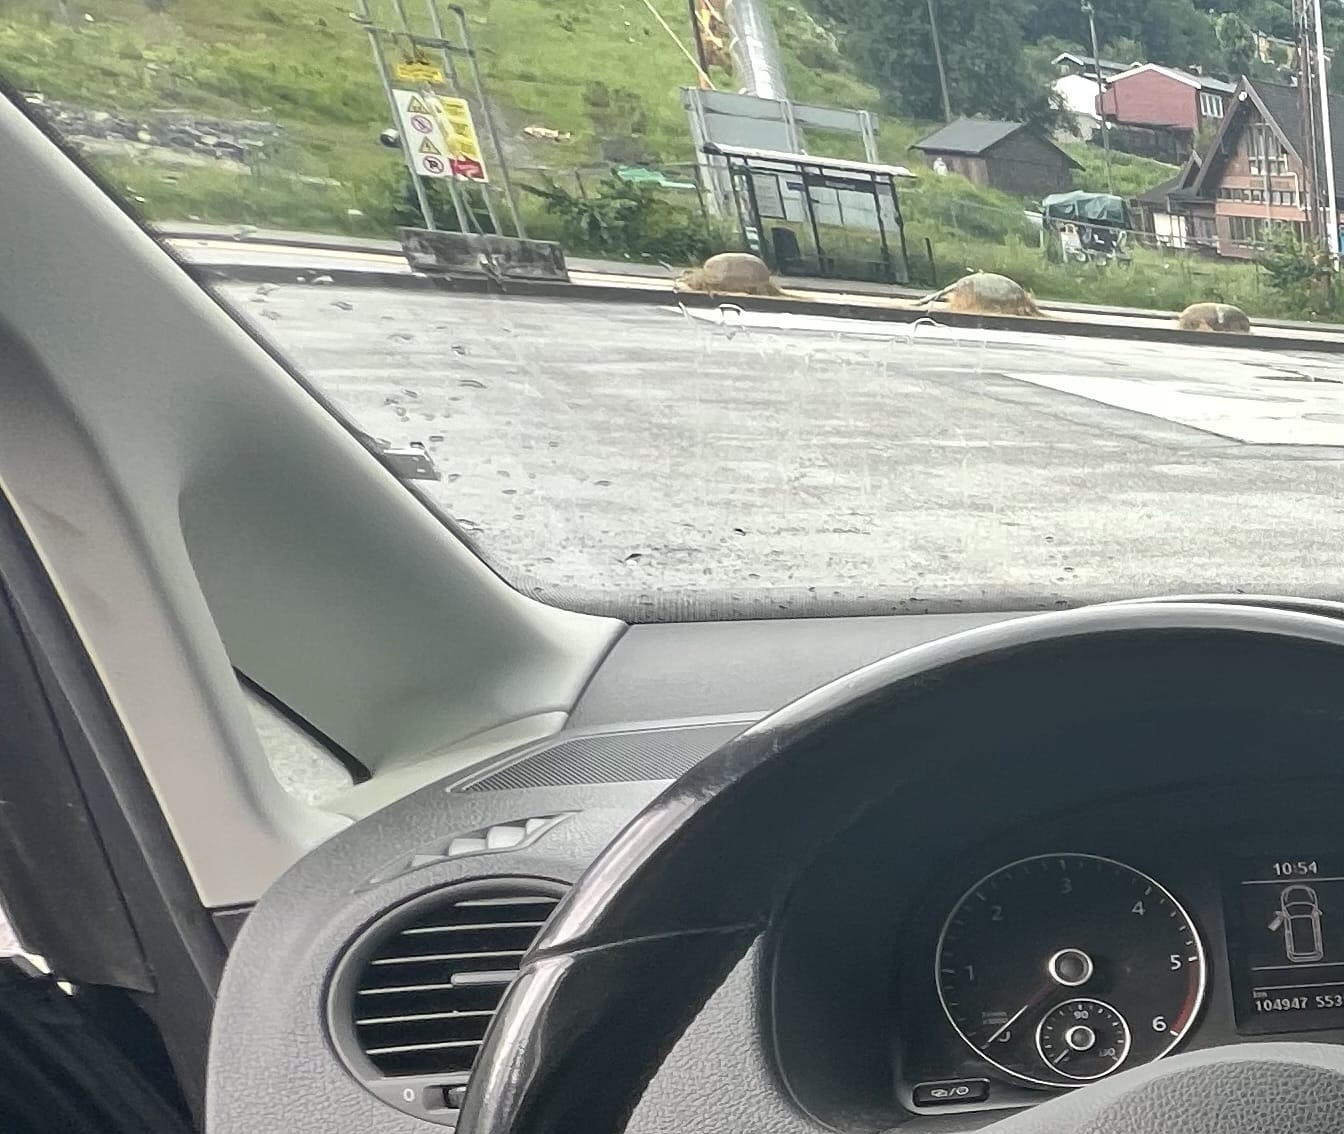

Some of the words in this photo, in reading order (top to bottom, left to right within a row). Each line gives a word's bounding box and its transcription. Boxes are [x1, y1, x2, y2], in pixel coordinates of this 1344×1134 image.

[1272, 861, 1319, 876] 10:54
[1060, 878, 1073, 893] 3
[992, 906, 1003, 921] 2
[1132, 901, 1146, 916] 4
[1170, 954, 1182, 970] 5
[966, 965, 975, 981] 1
[1255, 997, 1308, 1012] 104947
[1152, 1016, 1167, 1031] 6
